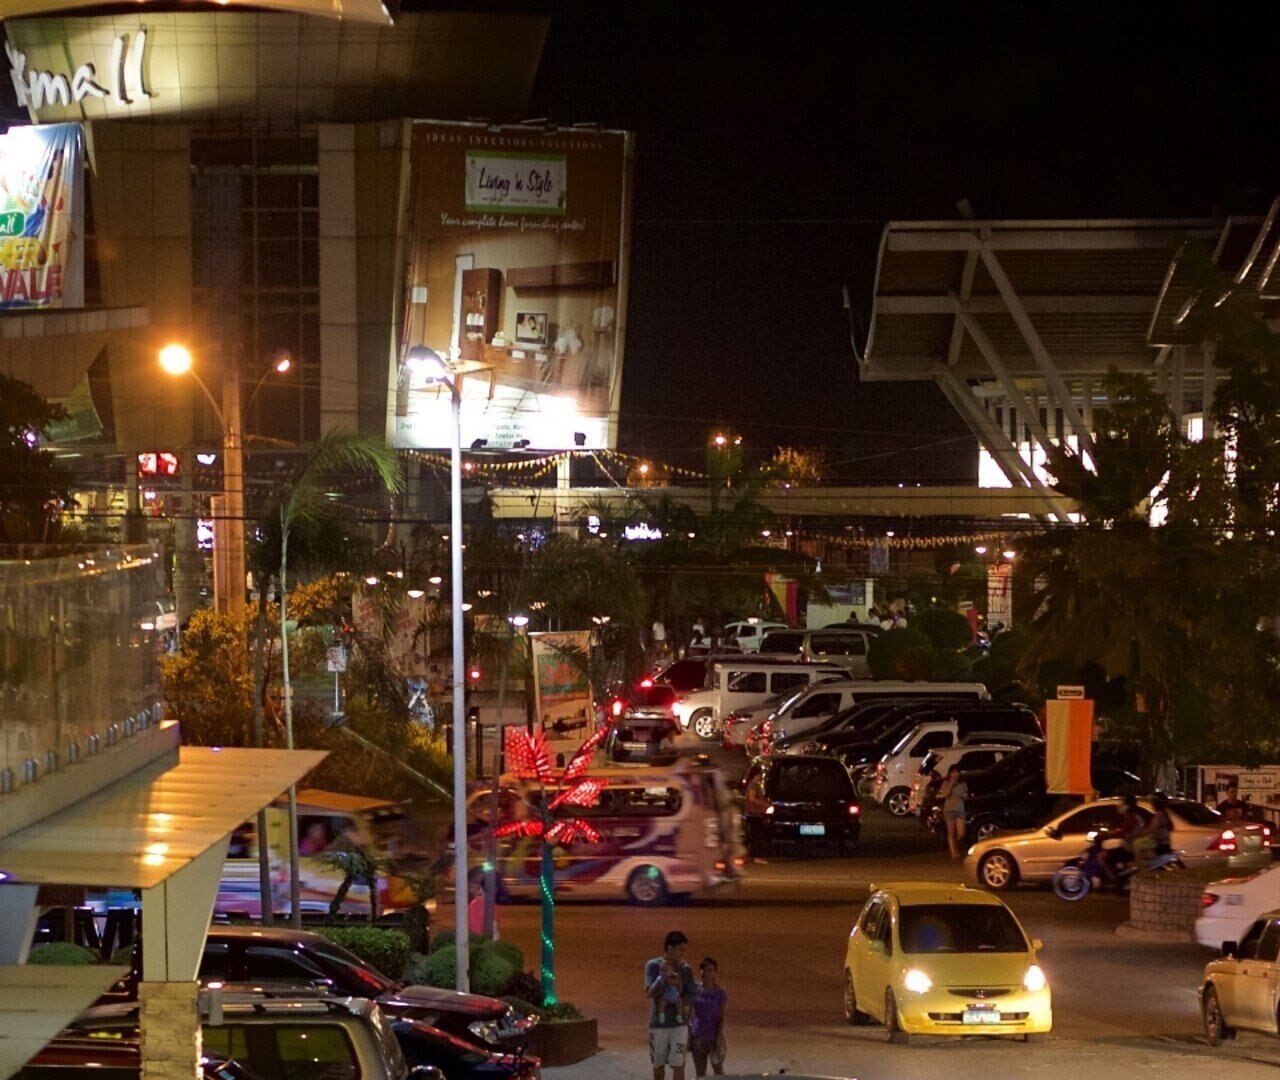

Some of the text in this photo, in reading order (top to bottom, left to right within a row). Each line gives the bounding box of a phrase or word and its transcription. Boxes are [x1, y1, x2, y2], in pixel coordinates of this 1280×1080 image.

[5, 30, 151, 109] kmall
[478, 168, 510, 196] Living
[526, 170, 553, 198] Style
[462, 215, 496, 230] complete
[498, 216, 519, 228] home
